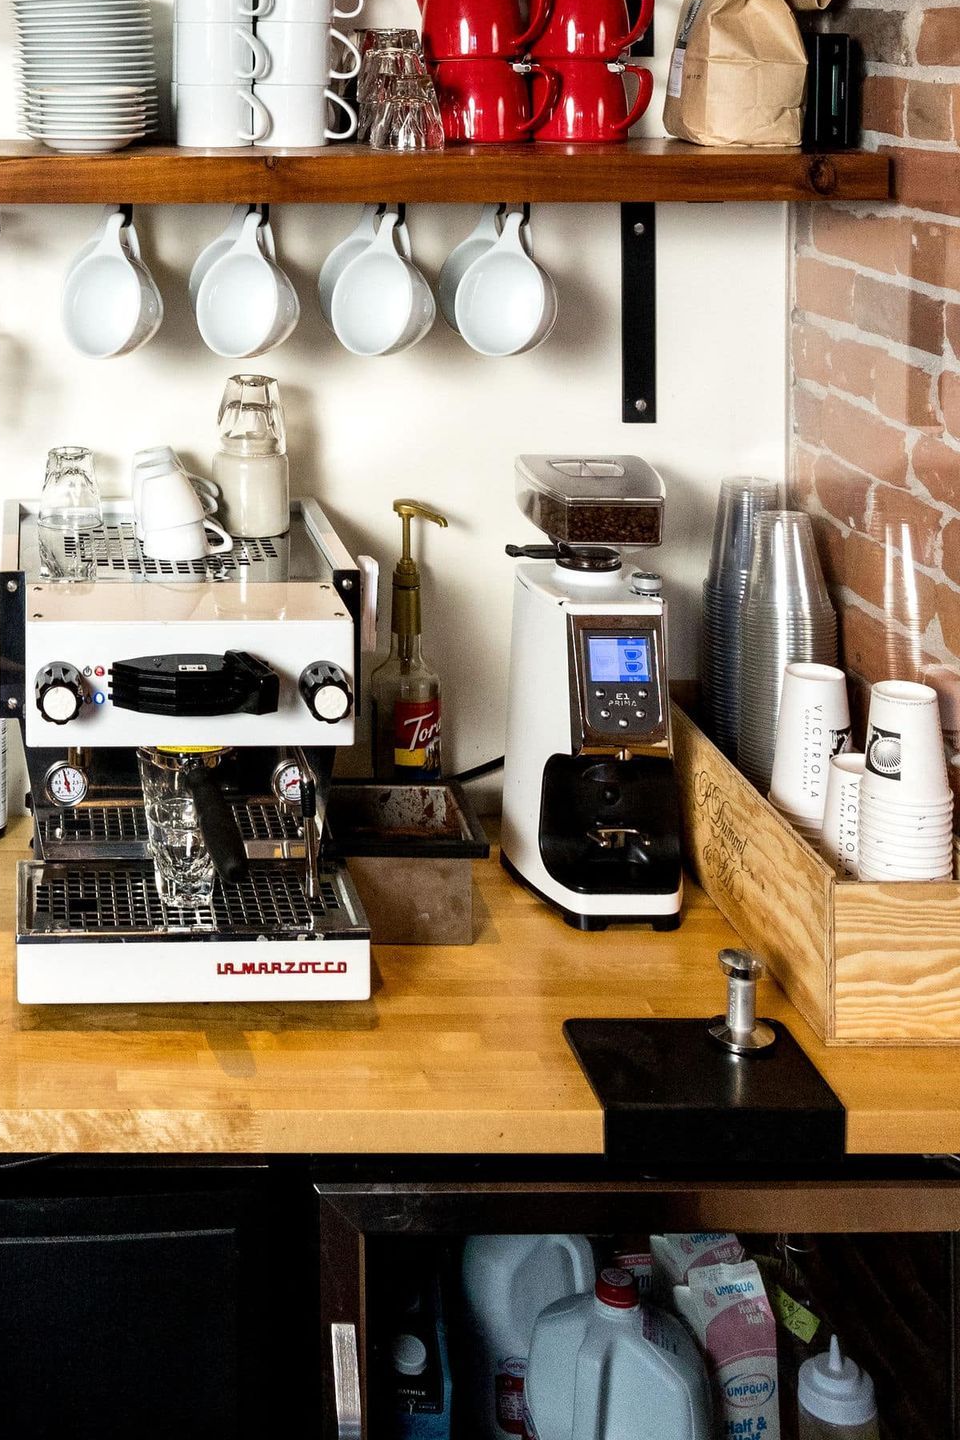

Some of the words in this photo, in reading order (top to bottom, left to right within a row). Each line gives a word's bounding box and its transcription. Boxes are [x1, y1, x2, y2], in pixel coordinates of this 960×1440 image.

[615, 692, 630, 700] E1
[810, 704, 823, 799] VICTROLA
[845, 782, 858, 876] VICTROLA
[217, 962, 234, 974] LA
[242, 961, 347, 974] MARZOCCO
[715, 1282, 754, 1296] UMPQUA
[737, 1301, 753, 1315] Half
[745, 1312, 765, 1325] Half
[727, 1383, 769, 1398] UMPQUA
[725, 1418, 754, 1435] Half
[755, 1417, 768, 1430] &
